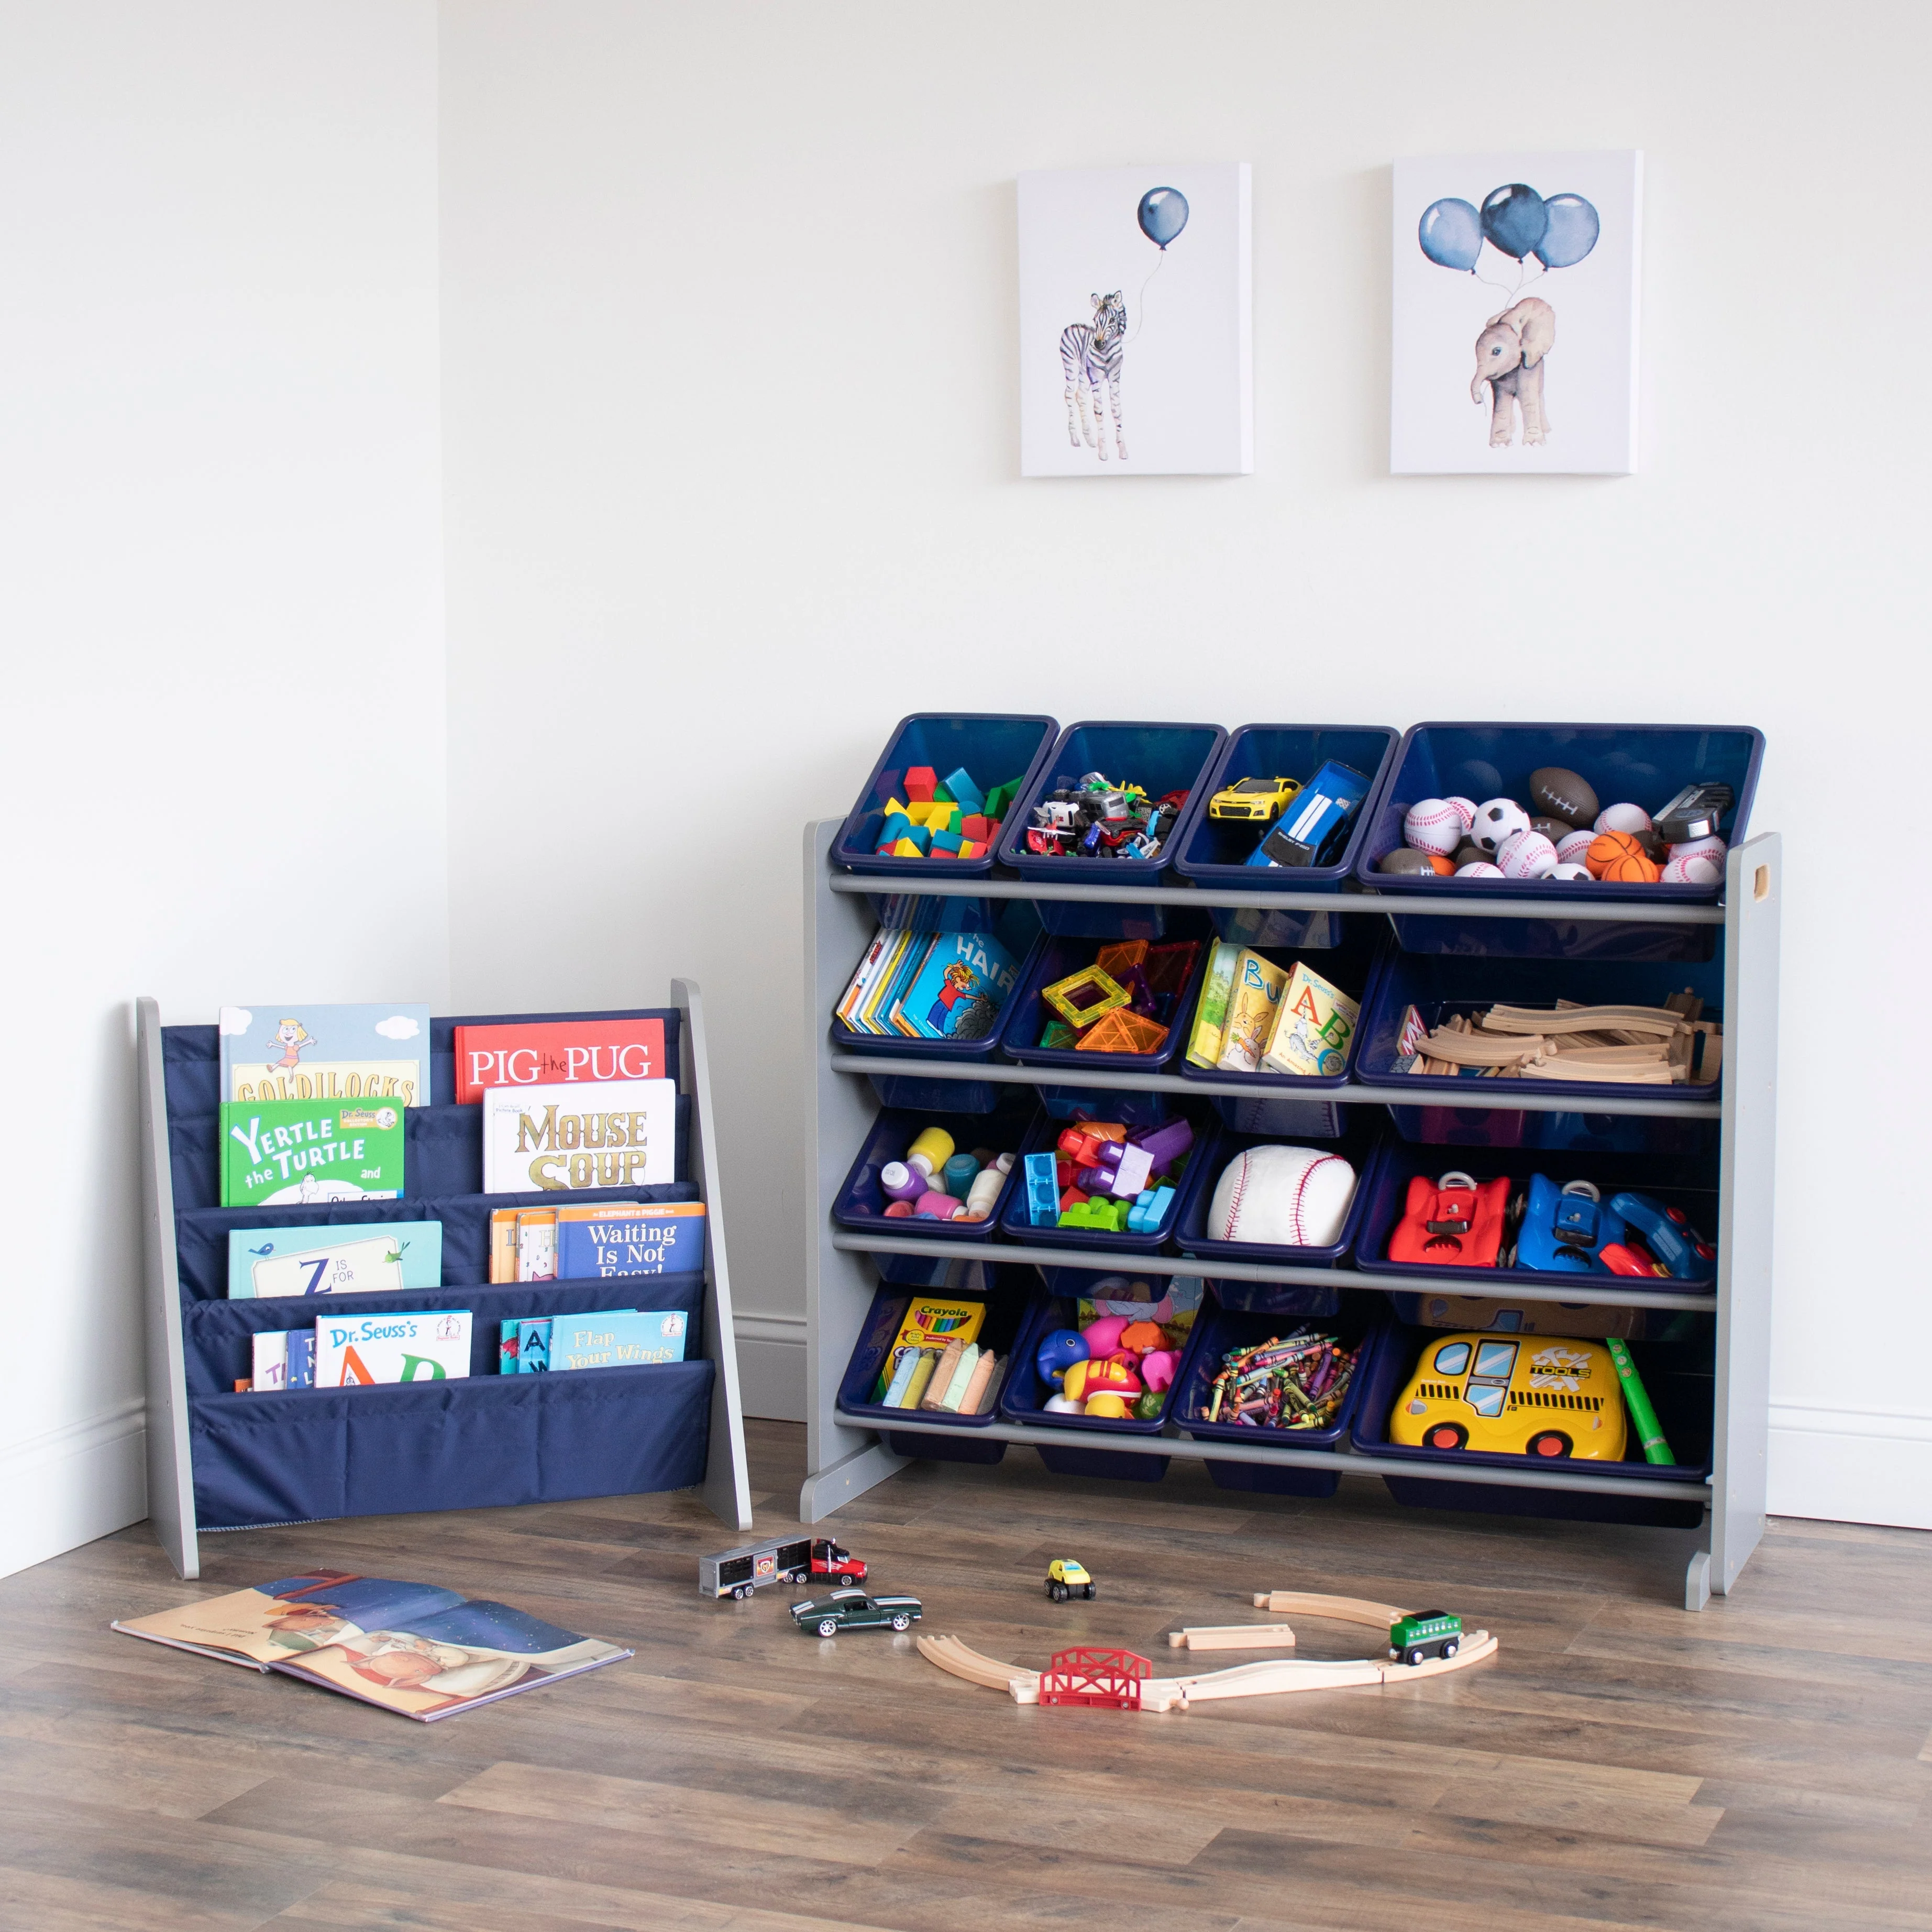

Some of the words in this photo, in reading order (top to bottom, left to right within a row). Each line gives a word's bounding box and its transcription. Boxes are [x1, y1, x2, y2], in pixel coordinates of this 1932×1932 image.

[957, 935, 1014, 996] HAIR
[1302, 973, 1312, 985] Dr.
[1313, 979, 1335, 999] Seuss's
[469, 1048, 541, 1085] PIG
[540, 1053, 567, 1074] the
[564, 1044, 652, 1080] PUG
[238, 1072, 414, 1107] GOLDILOCKS
[341, 1110, 353, 1119] Dr.
[355, 1108, 376, 1118] Seuss
[230, 1117, 332, 1166] YERTLE
[514, 1105, 647, 1153] MOUSE
[245, 1168, 273, 1188] the
[272, 1139, 365, 1179] TURTLE
[361, 1166, 381, 1179] and
[529, 1151, 647, 1191] SOUP
[588, 1223, 677, 1246] Waiting
[596, 1246, 617, 1265] Is
[626, 1243, 665, 1263] Not
[299, 1258, 332, 1295] Z
[336, 1260, 347, 1271] IS
[333, 1270, 354, 1284] FOR
[600, 1264, 663, 1277] Ea!
[920, 1305, 968, 1317] Crayola
[330, 1327, 358, 1349] Dr.
[361, 1320, 418, 1341] Seuss's
[573, 1330, 615, 1349] Flap
[567, 1351, 611, 1370] Your
[616, 1343, 675, 1364] Wings
[1532, 1365, 1591, 1378] TOOLS
